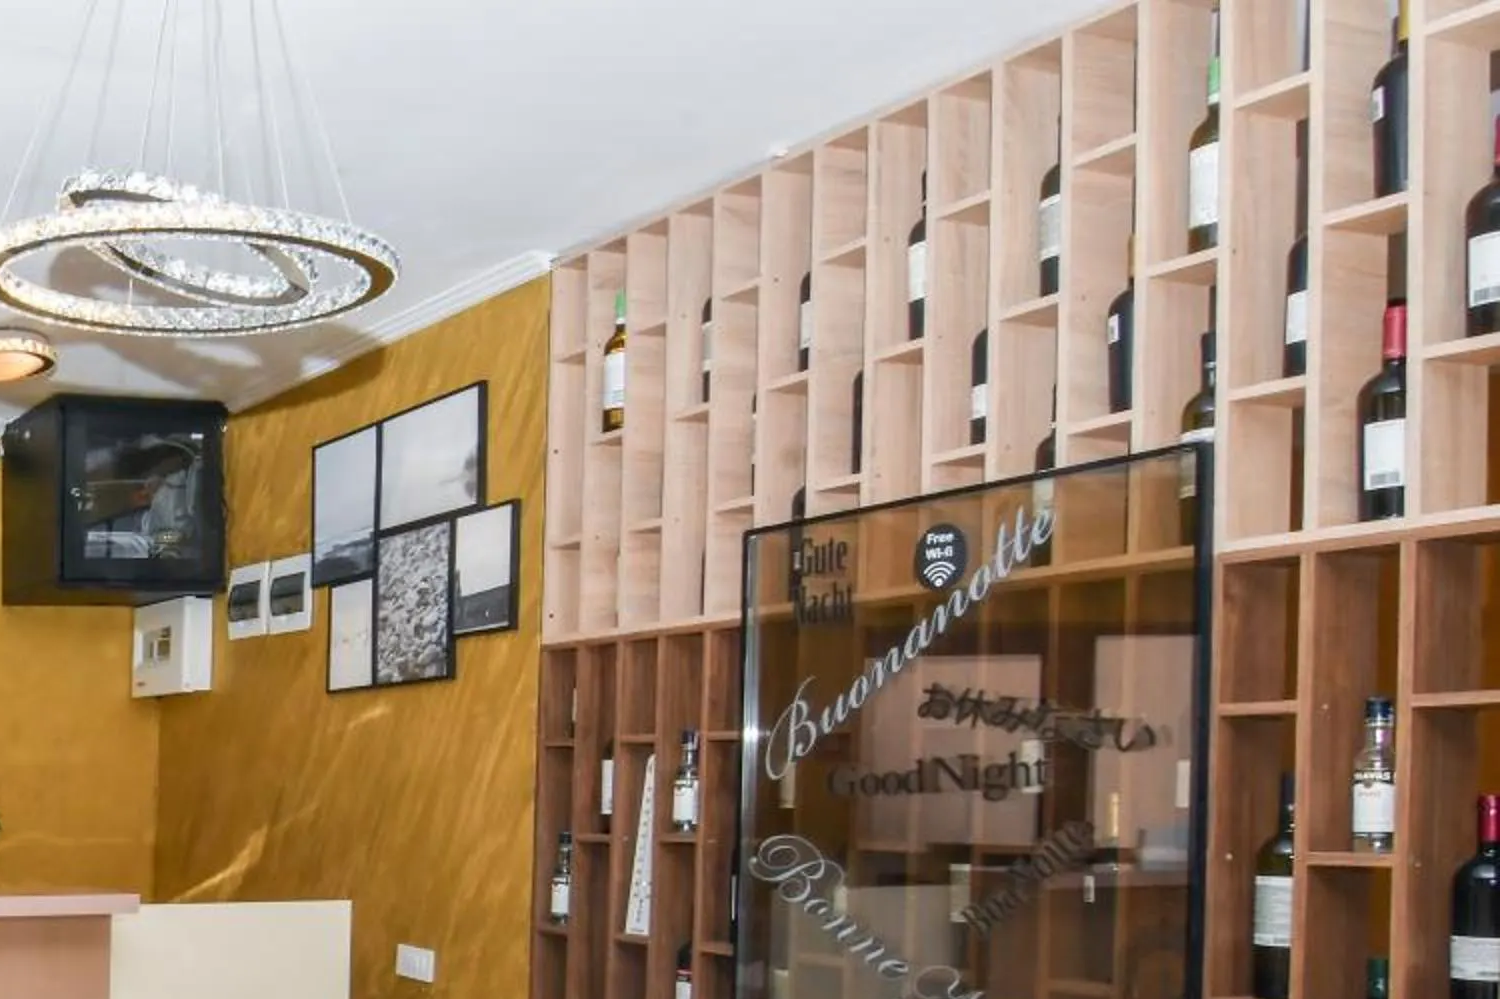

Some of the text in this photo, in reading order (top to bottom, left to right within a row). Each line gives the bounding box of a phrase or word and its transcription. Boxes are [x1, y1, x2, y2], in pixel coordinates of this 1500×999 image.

[800, 537, 848, 577] Gute
[925, 531, 955, 545] Free
[765, 505, 1057, 781] Buonanotte
[749, 834, 909, 982] Bonne
